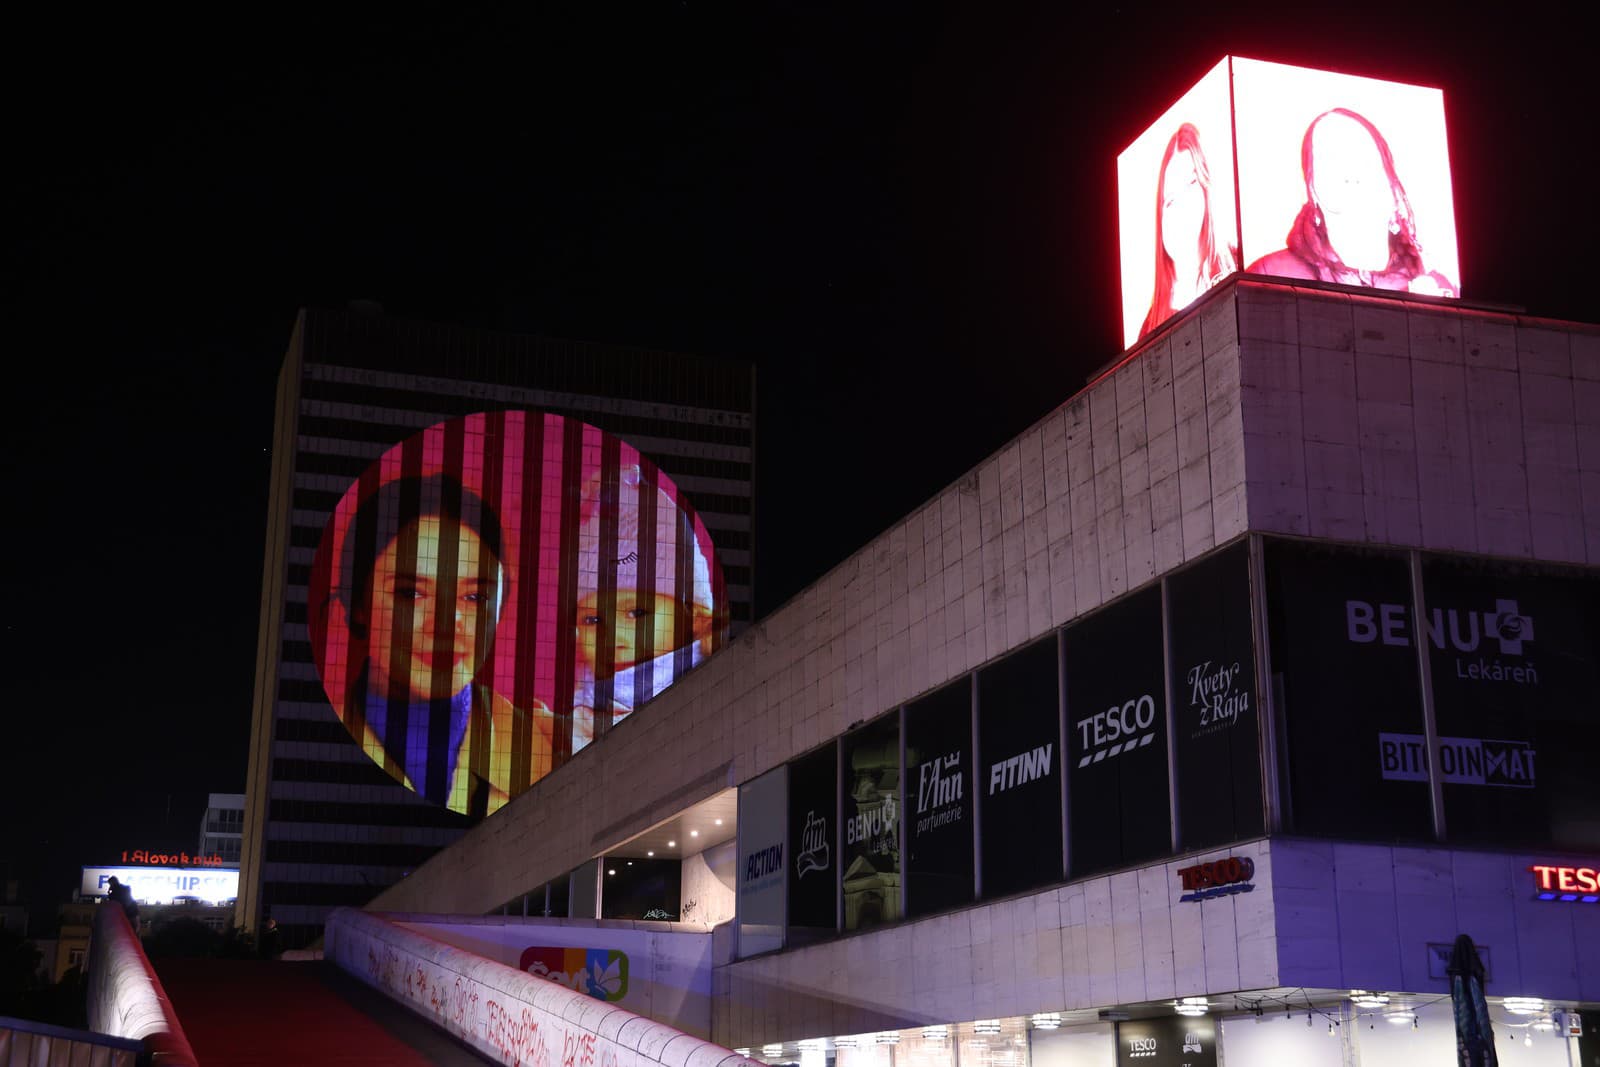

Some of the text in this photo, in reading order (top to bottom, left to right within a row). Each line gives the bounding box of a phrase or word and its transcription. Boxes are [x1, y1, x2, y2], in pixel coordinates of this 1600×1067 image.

[1346, 600, 1480, 652] BENU
[1187, 661, 1240, 706] Kvety
[1456, 657, 1538, 684] Lekáreň
[1077, 694, 1155, 750] TESCO
[1200, 688, 1249, 728] z Raja
[989, 743, 1053, 796] FITINN
[848, 808, 881, 845] BENU
[746, 843, 783, 881] ACTION
[1178, 857, 1252, 890] TESCO
[1533, 865, 1600, 892] TES
[1129, 1037, 1157, 1051] TESCO
